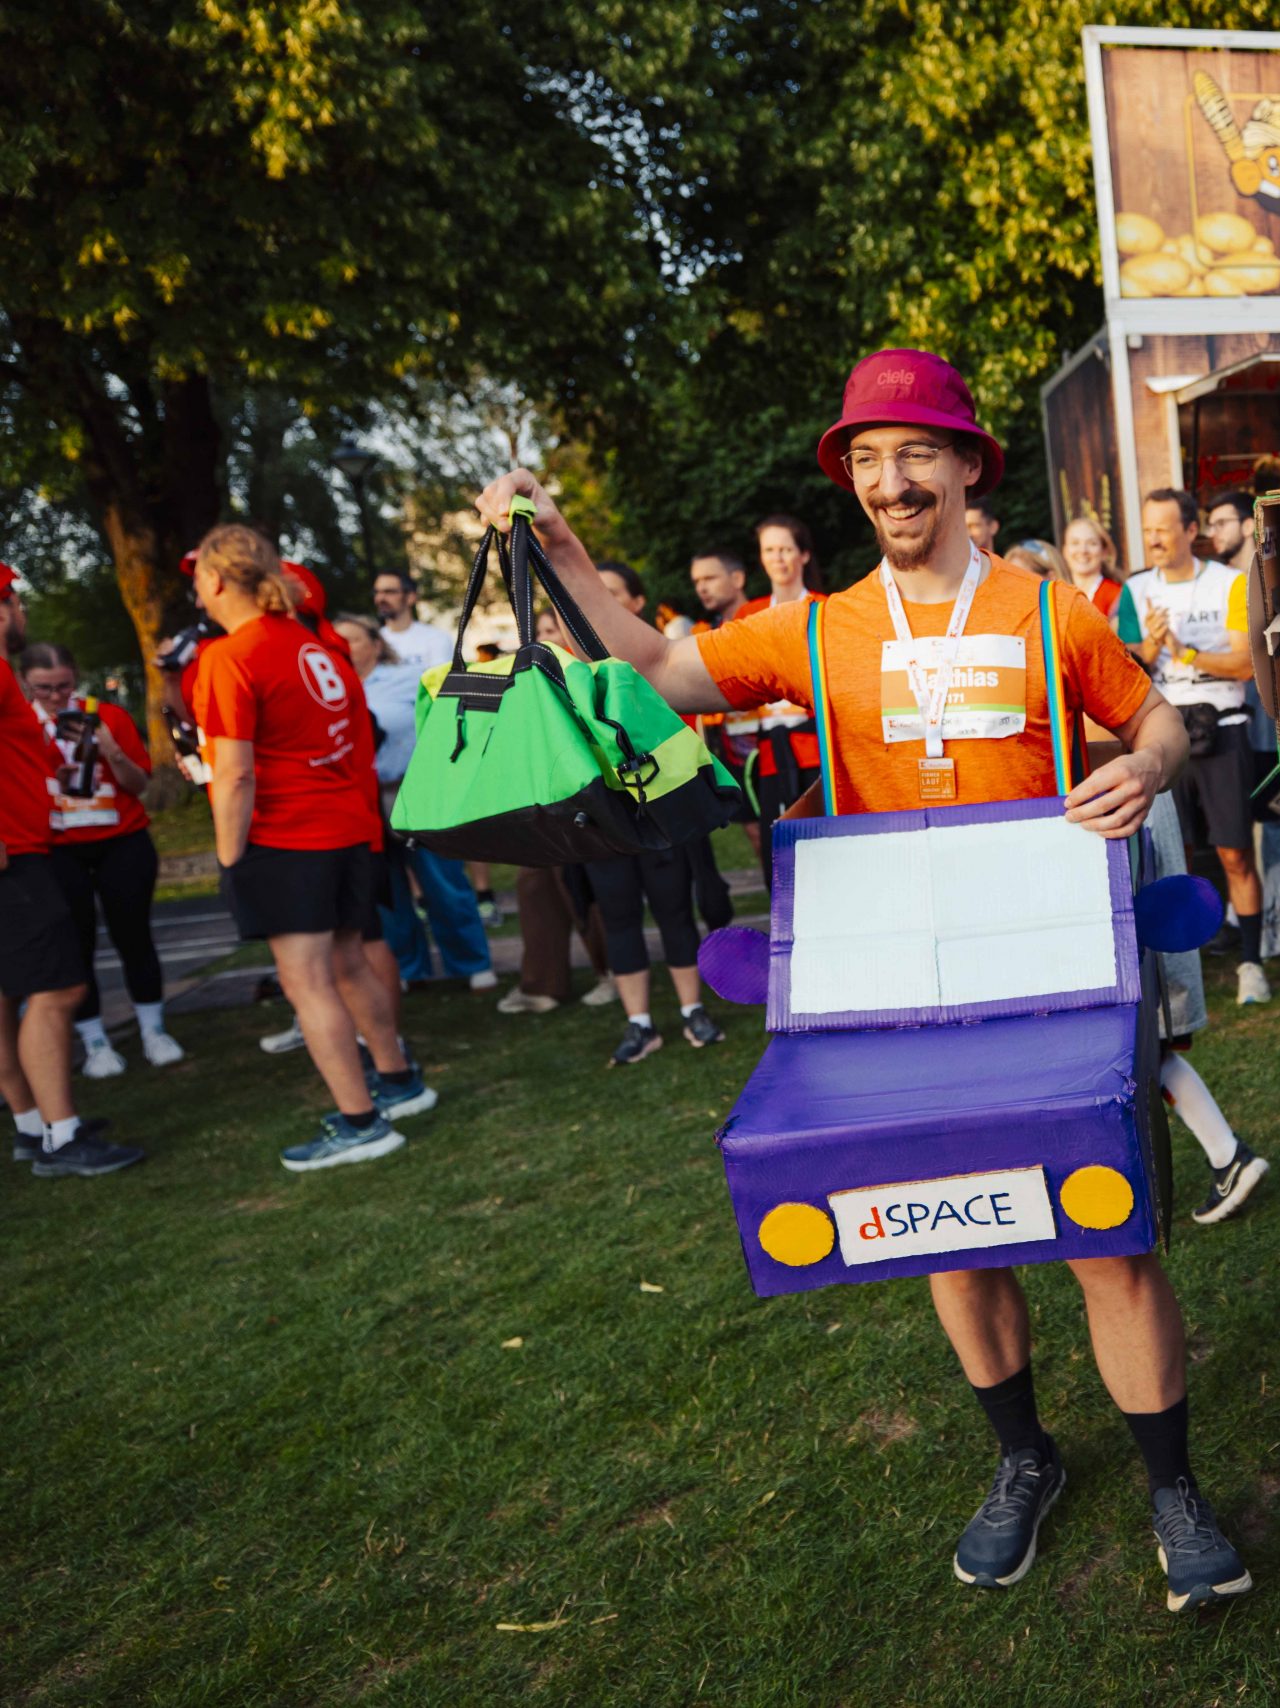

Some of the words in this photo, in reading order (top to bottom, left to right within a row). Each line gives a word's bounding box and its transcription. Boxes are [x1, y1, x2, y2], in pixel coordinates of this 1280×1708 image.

[877, 369, 915, 386] ciele
[305, 651, 346, 702] B
[858, 1191, 1016, 1240] dSPACE
